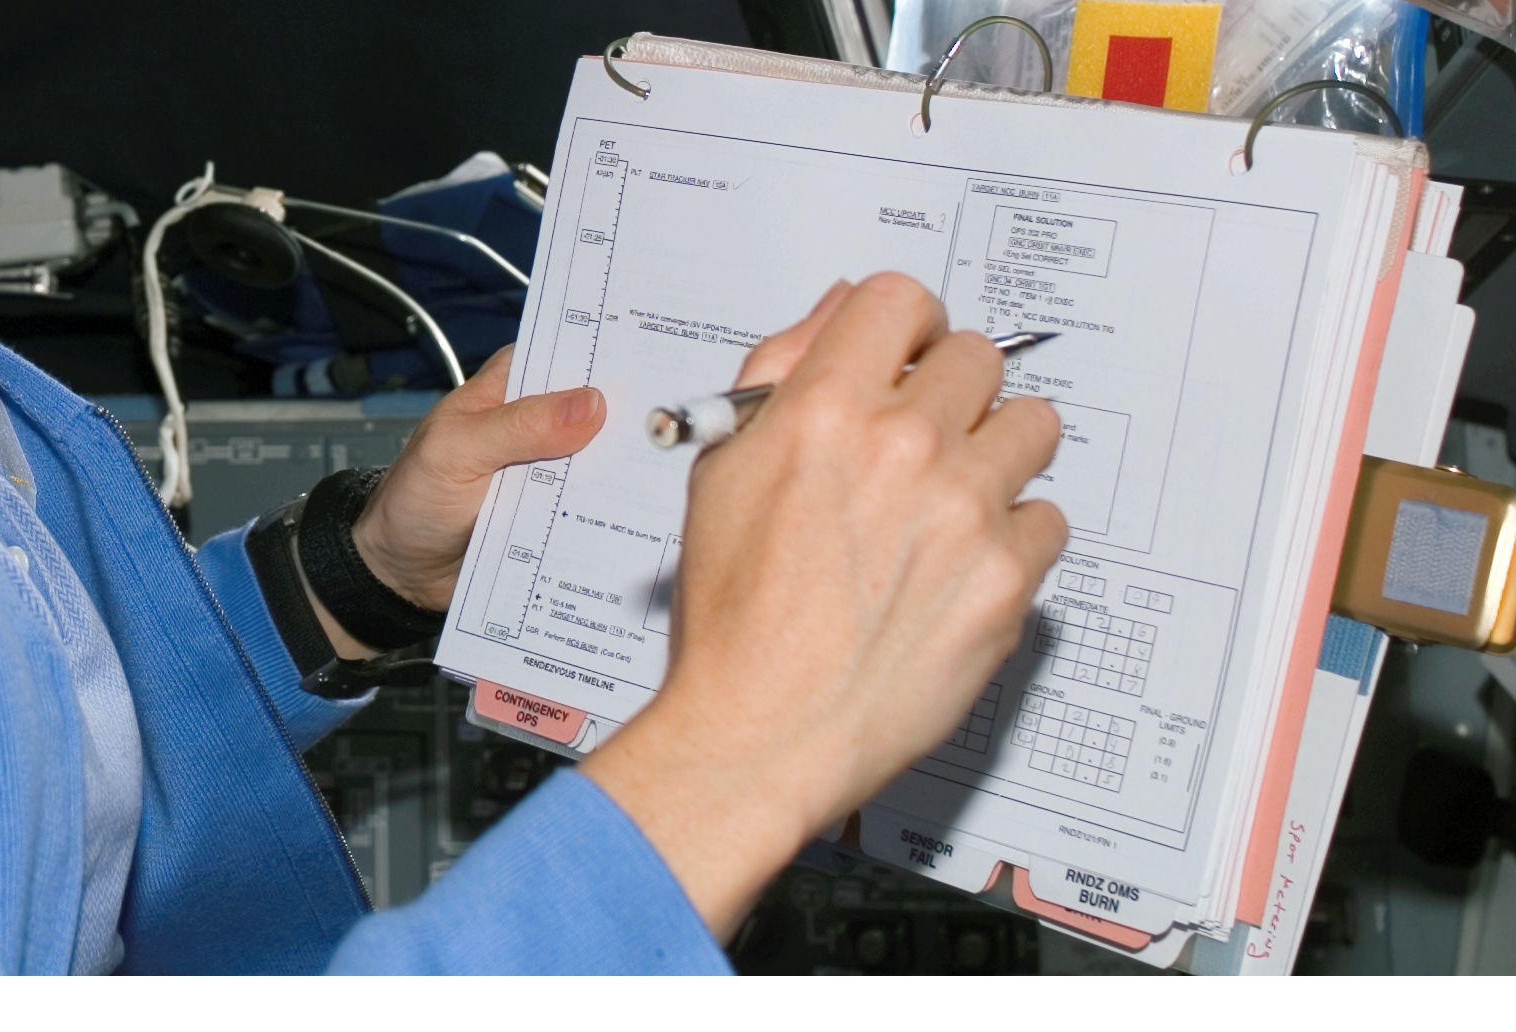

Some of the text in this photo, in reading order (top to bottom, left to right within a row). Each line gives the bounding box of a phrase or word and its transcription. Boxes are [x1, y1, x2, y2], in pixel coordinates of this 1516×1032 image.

[600, 140, 616, 150] PET
[1013, 213, 1073, 228] FINAL SOLUTION
[1041, 231, 1057, 239] PRO
[1033, 254, 1069, 265] CORRECT
[1051, 594, 1109, 614] INTERMEDIATE
[523, 656, 615, 692] RENDEZVOUS TIMELINE
[1030, 683, 1066, 699] GROUND
[495, 689, 569, 722] CONTINGENCY
[1140, 705, 1163, 718] FINAL
[516, 711, 538, 727] OPS
[900, 828, 954, 857] SENSOR
[908, 848, 937, 869] FAIL
[1066, 868, 1140, 901] RNDZ OMS
[1079, 889, 1120, 913] BURN
